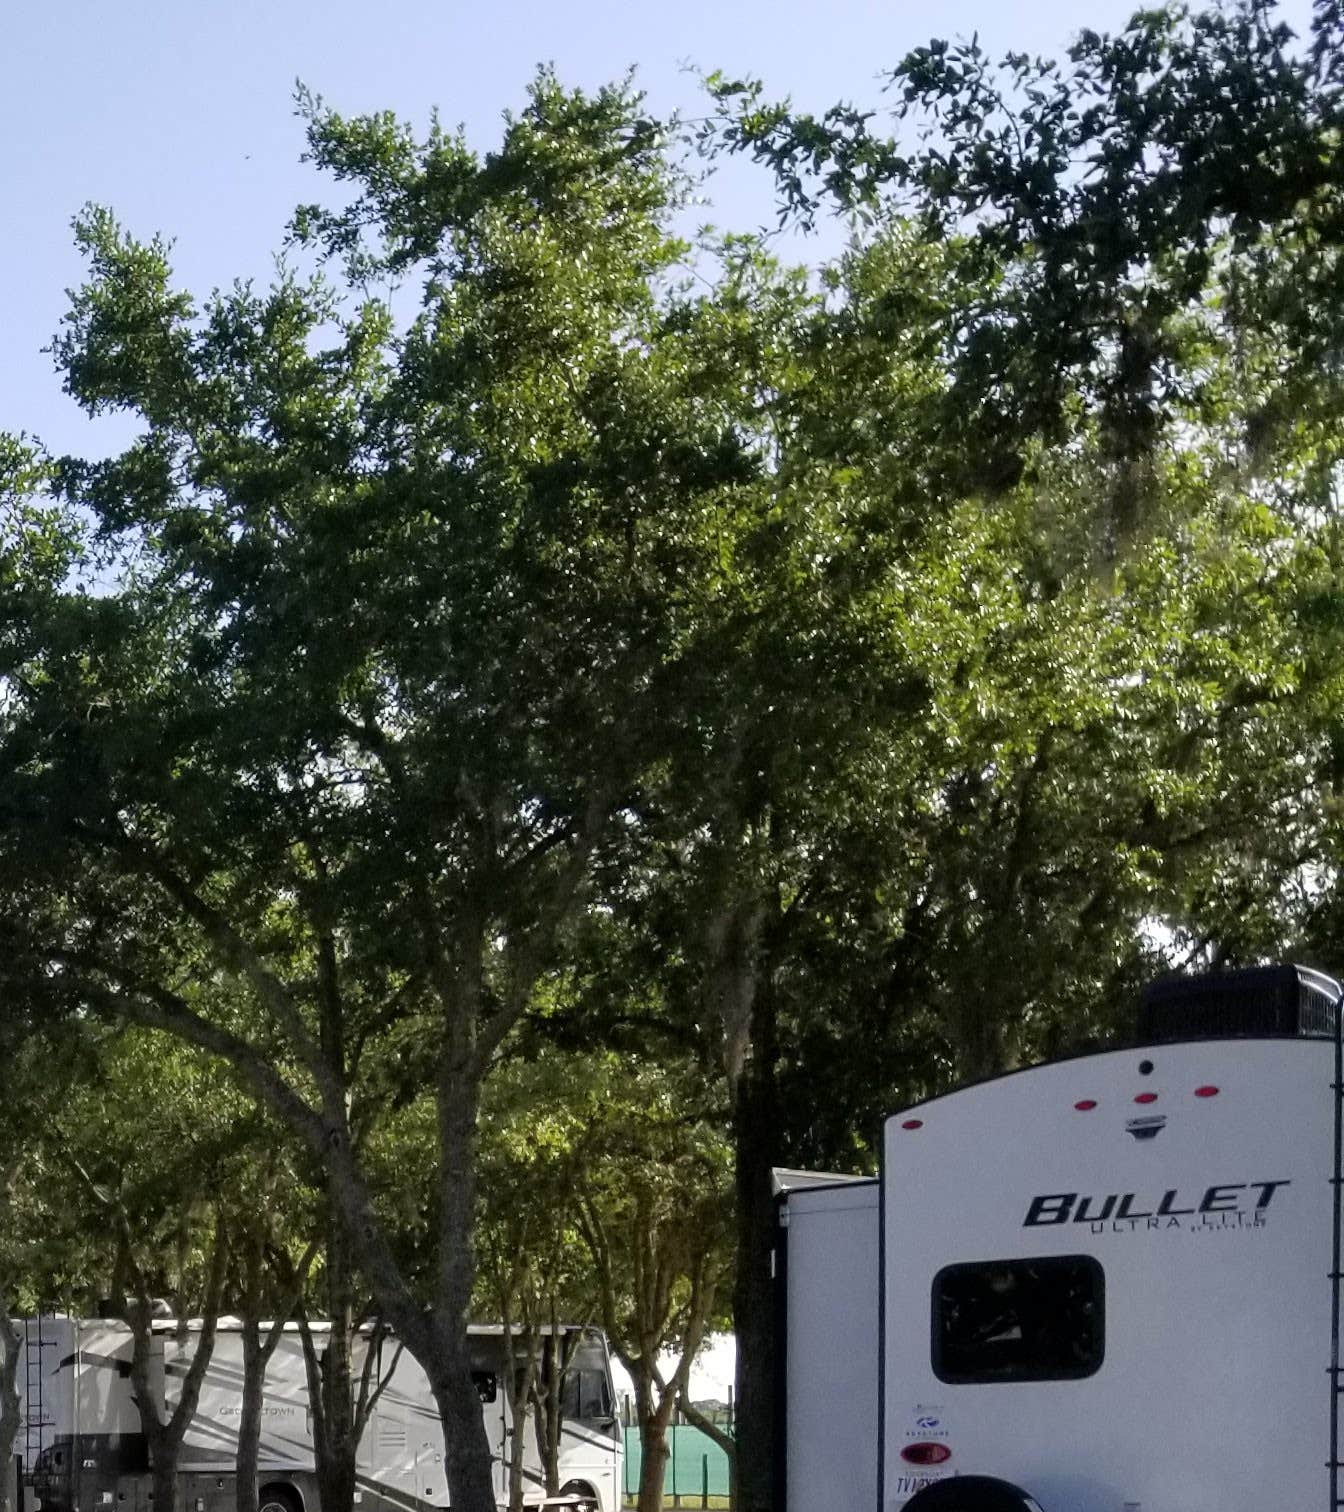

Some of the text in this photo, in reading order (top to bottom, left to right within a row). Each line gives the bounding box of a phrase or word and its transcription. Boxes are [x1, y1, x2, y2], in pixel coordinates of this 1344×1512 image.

[1023, 1180, 1291, 1227] BULLET
[1091, 1215, 1181, 1234] ULTRA
[1202, 1210, 1266, 1227] LITE
